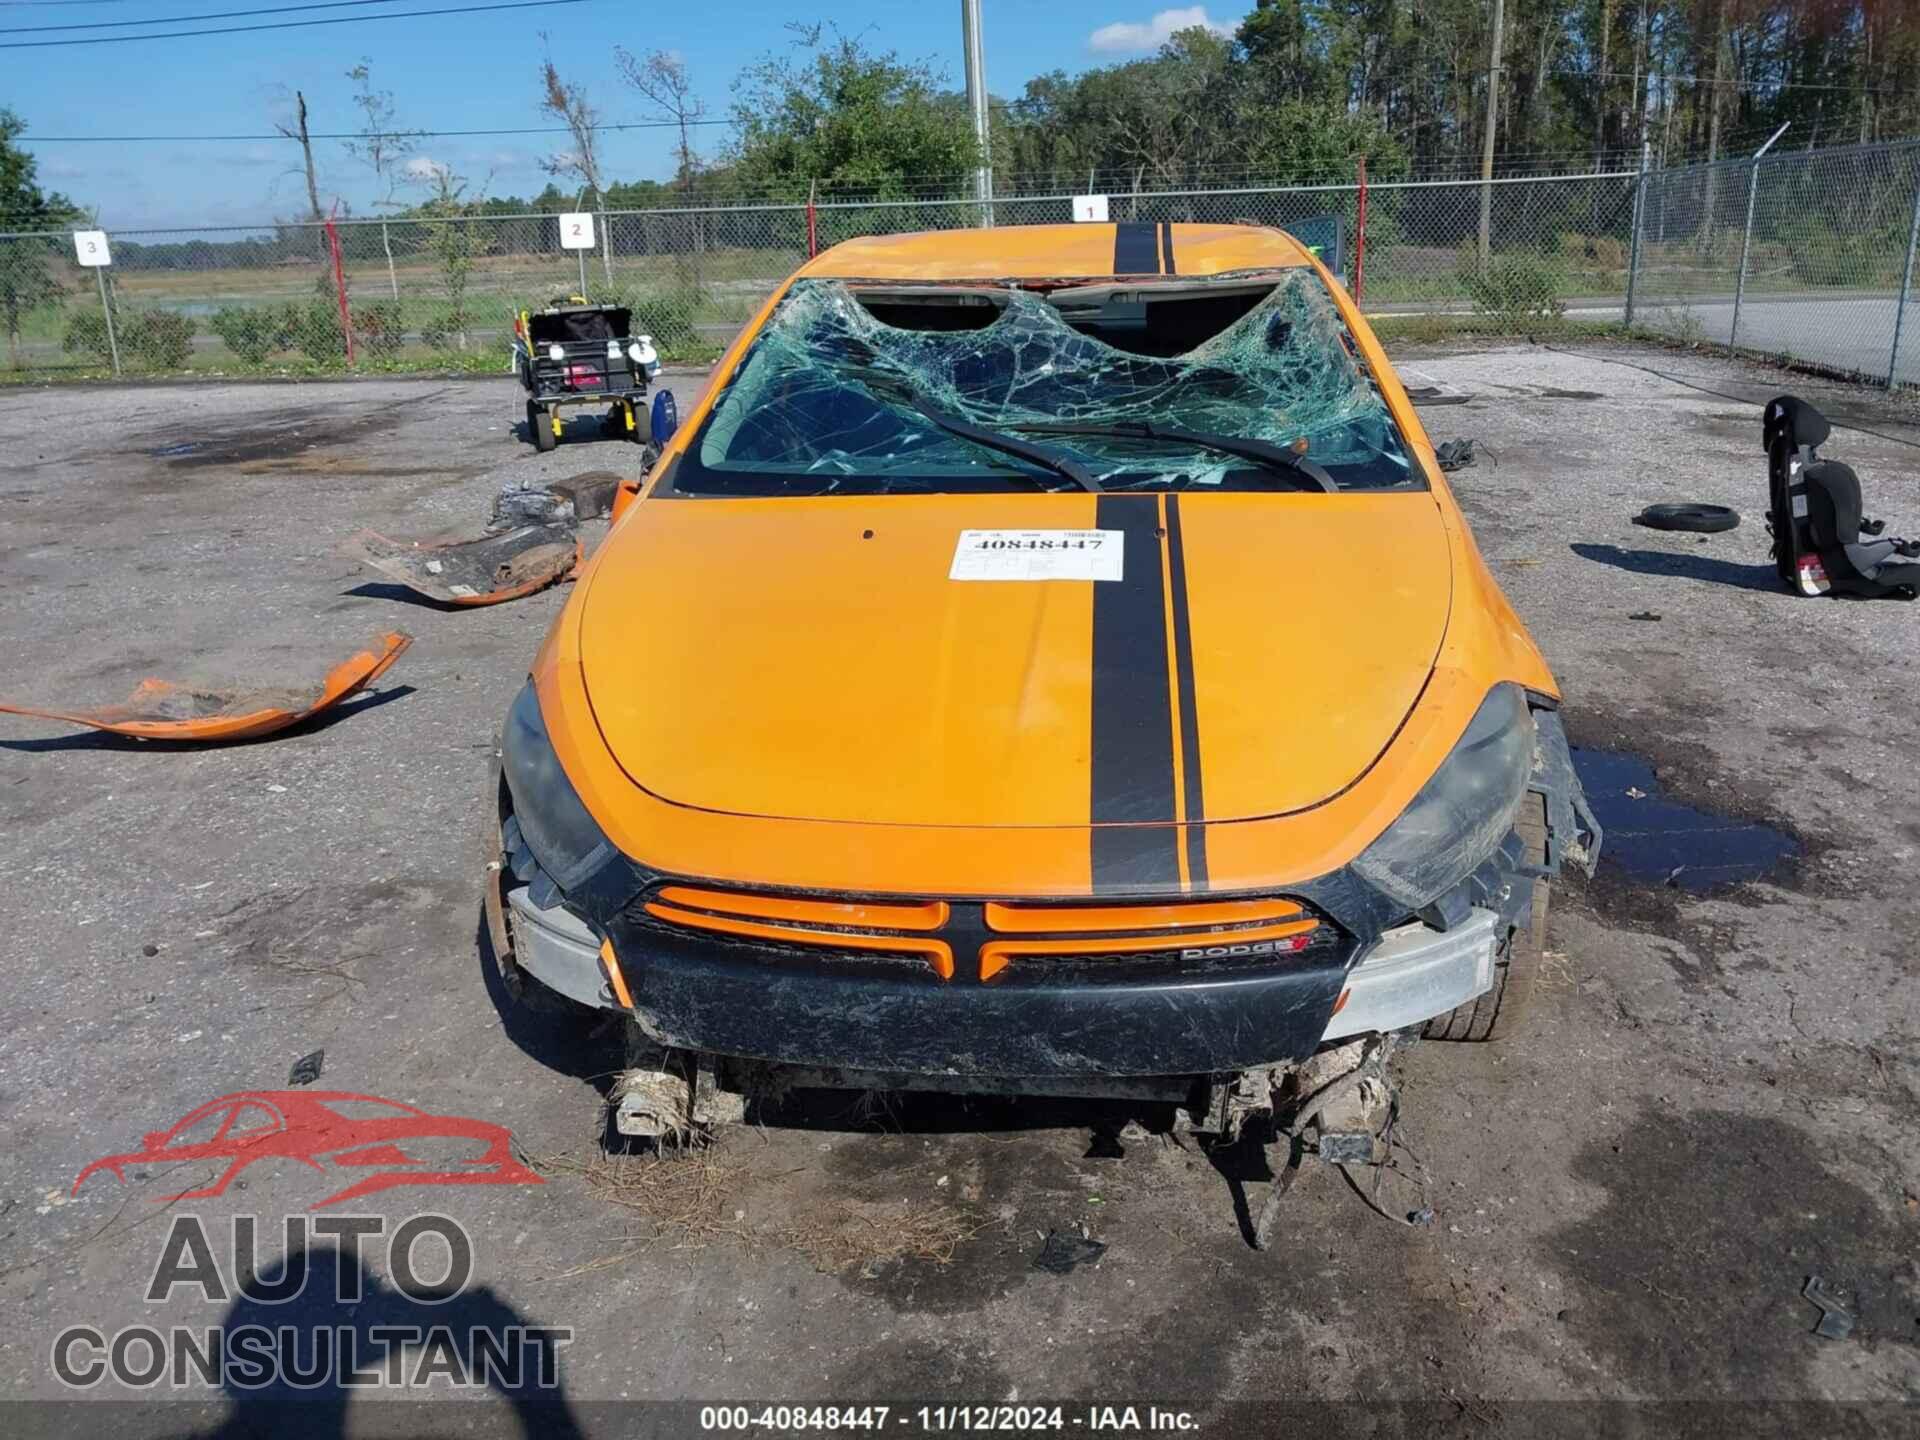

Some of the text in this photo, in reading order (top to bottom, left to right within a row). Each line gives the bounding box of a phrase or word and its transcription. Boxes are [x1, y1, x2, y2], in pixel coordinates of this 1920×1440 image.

[1086, 206, 1093, 218] 1
[572, 223, 582, 236] 2
[87, 241, 97, 253] 3
[974, 539, 1103, 550] 40848447
[1181, 940, 1292, 960] DODGE
